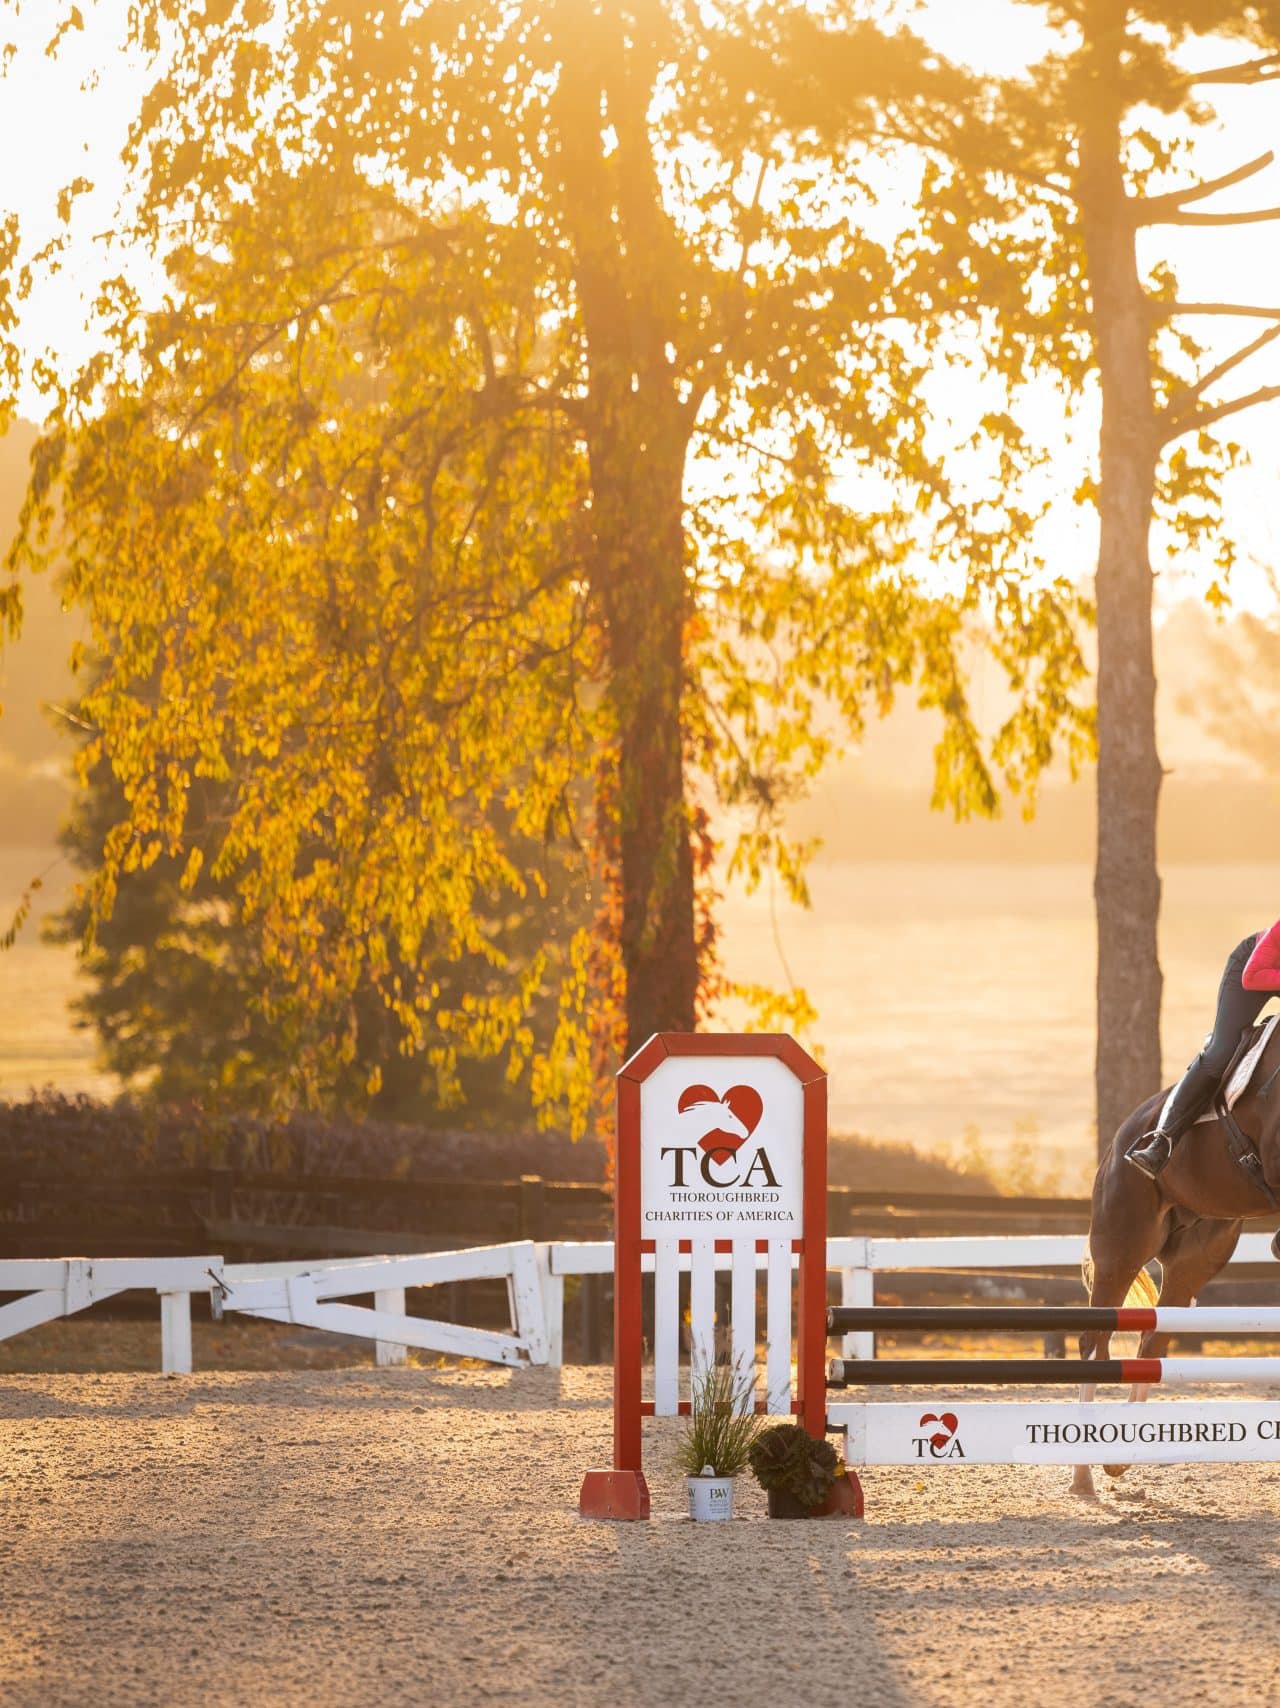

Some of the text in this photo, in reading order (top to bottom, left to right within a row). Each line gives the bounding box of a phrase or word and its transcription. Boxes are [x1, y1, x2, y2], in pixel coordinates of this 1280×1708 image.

[661, 1147, 782, 1188] TCA
[670, 1192, 779, 1203] THOROUGHBRED
[645, 1211, 794, 1222] CHARITIES OF AMERICA
[1026, 1423, 1247, 1444] THOROUGHBRED
[912, 1438, 966, 1458] TCA
